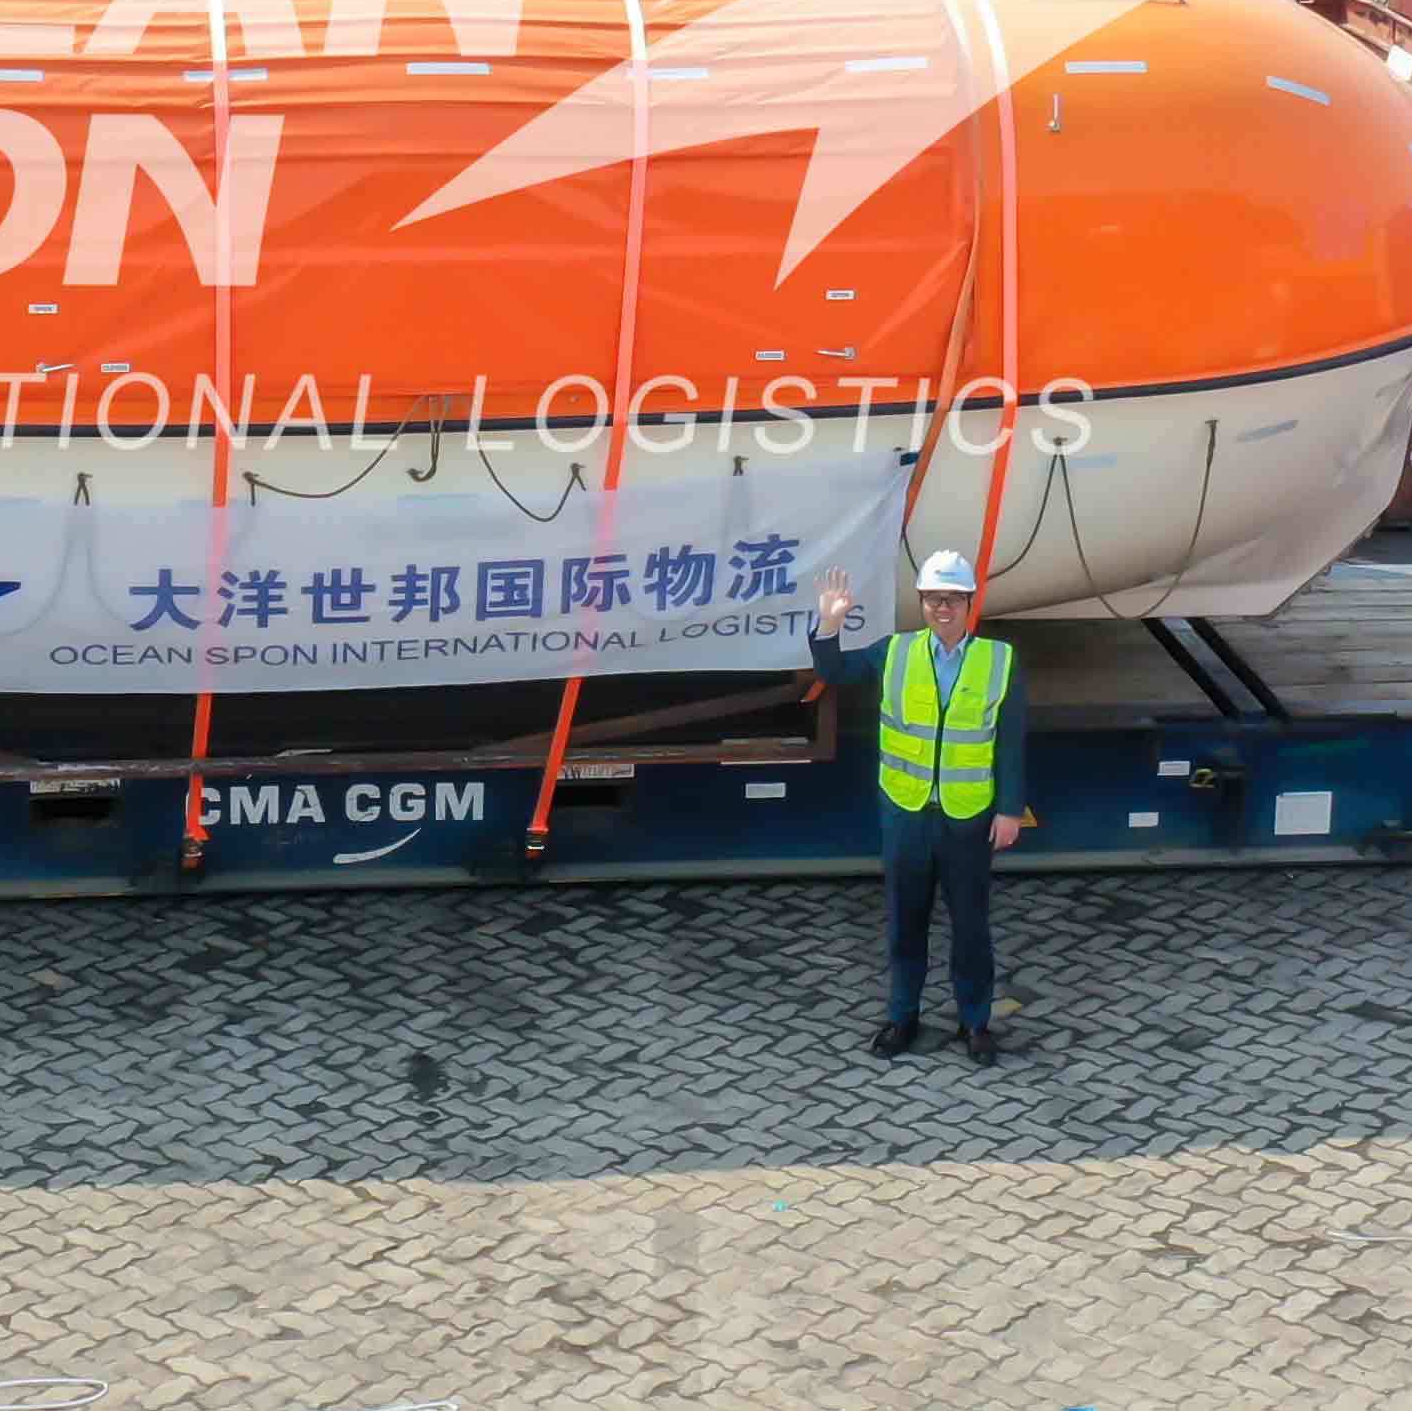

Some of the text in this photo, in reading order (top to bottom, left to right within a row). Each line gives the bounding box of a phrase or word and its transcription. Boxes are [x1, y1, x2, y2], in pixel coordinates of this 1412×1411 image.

[128, 533, 801, 632] 大洋世邦国际物流
[49, 604, 866, 667] OCEAN SPON INTERNATIONAL LOGISTIS
[184, 782, 486, 825] CMA CGM
